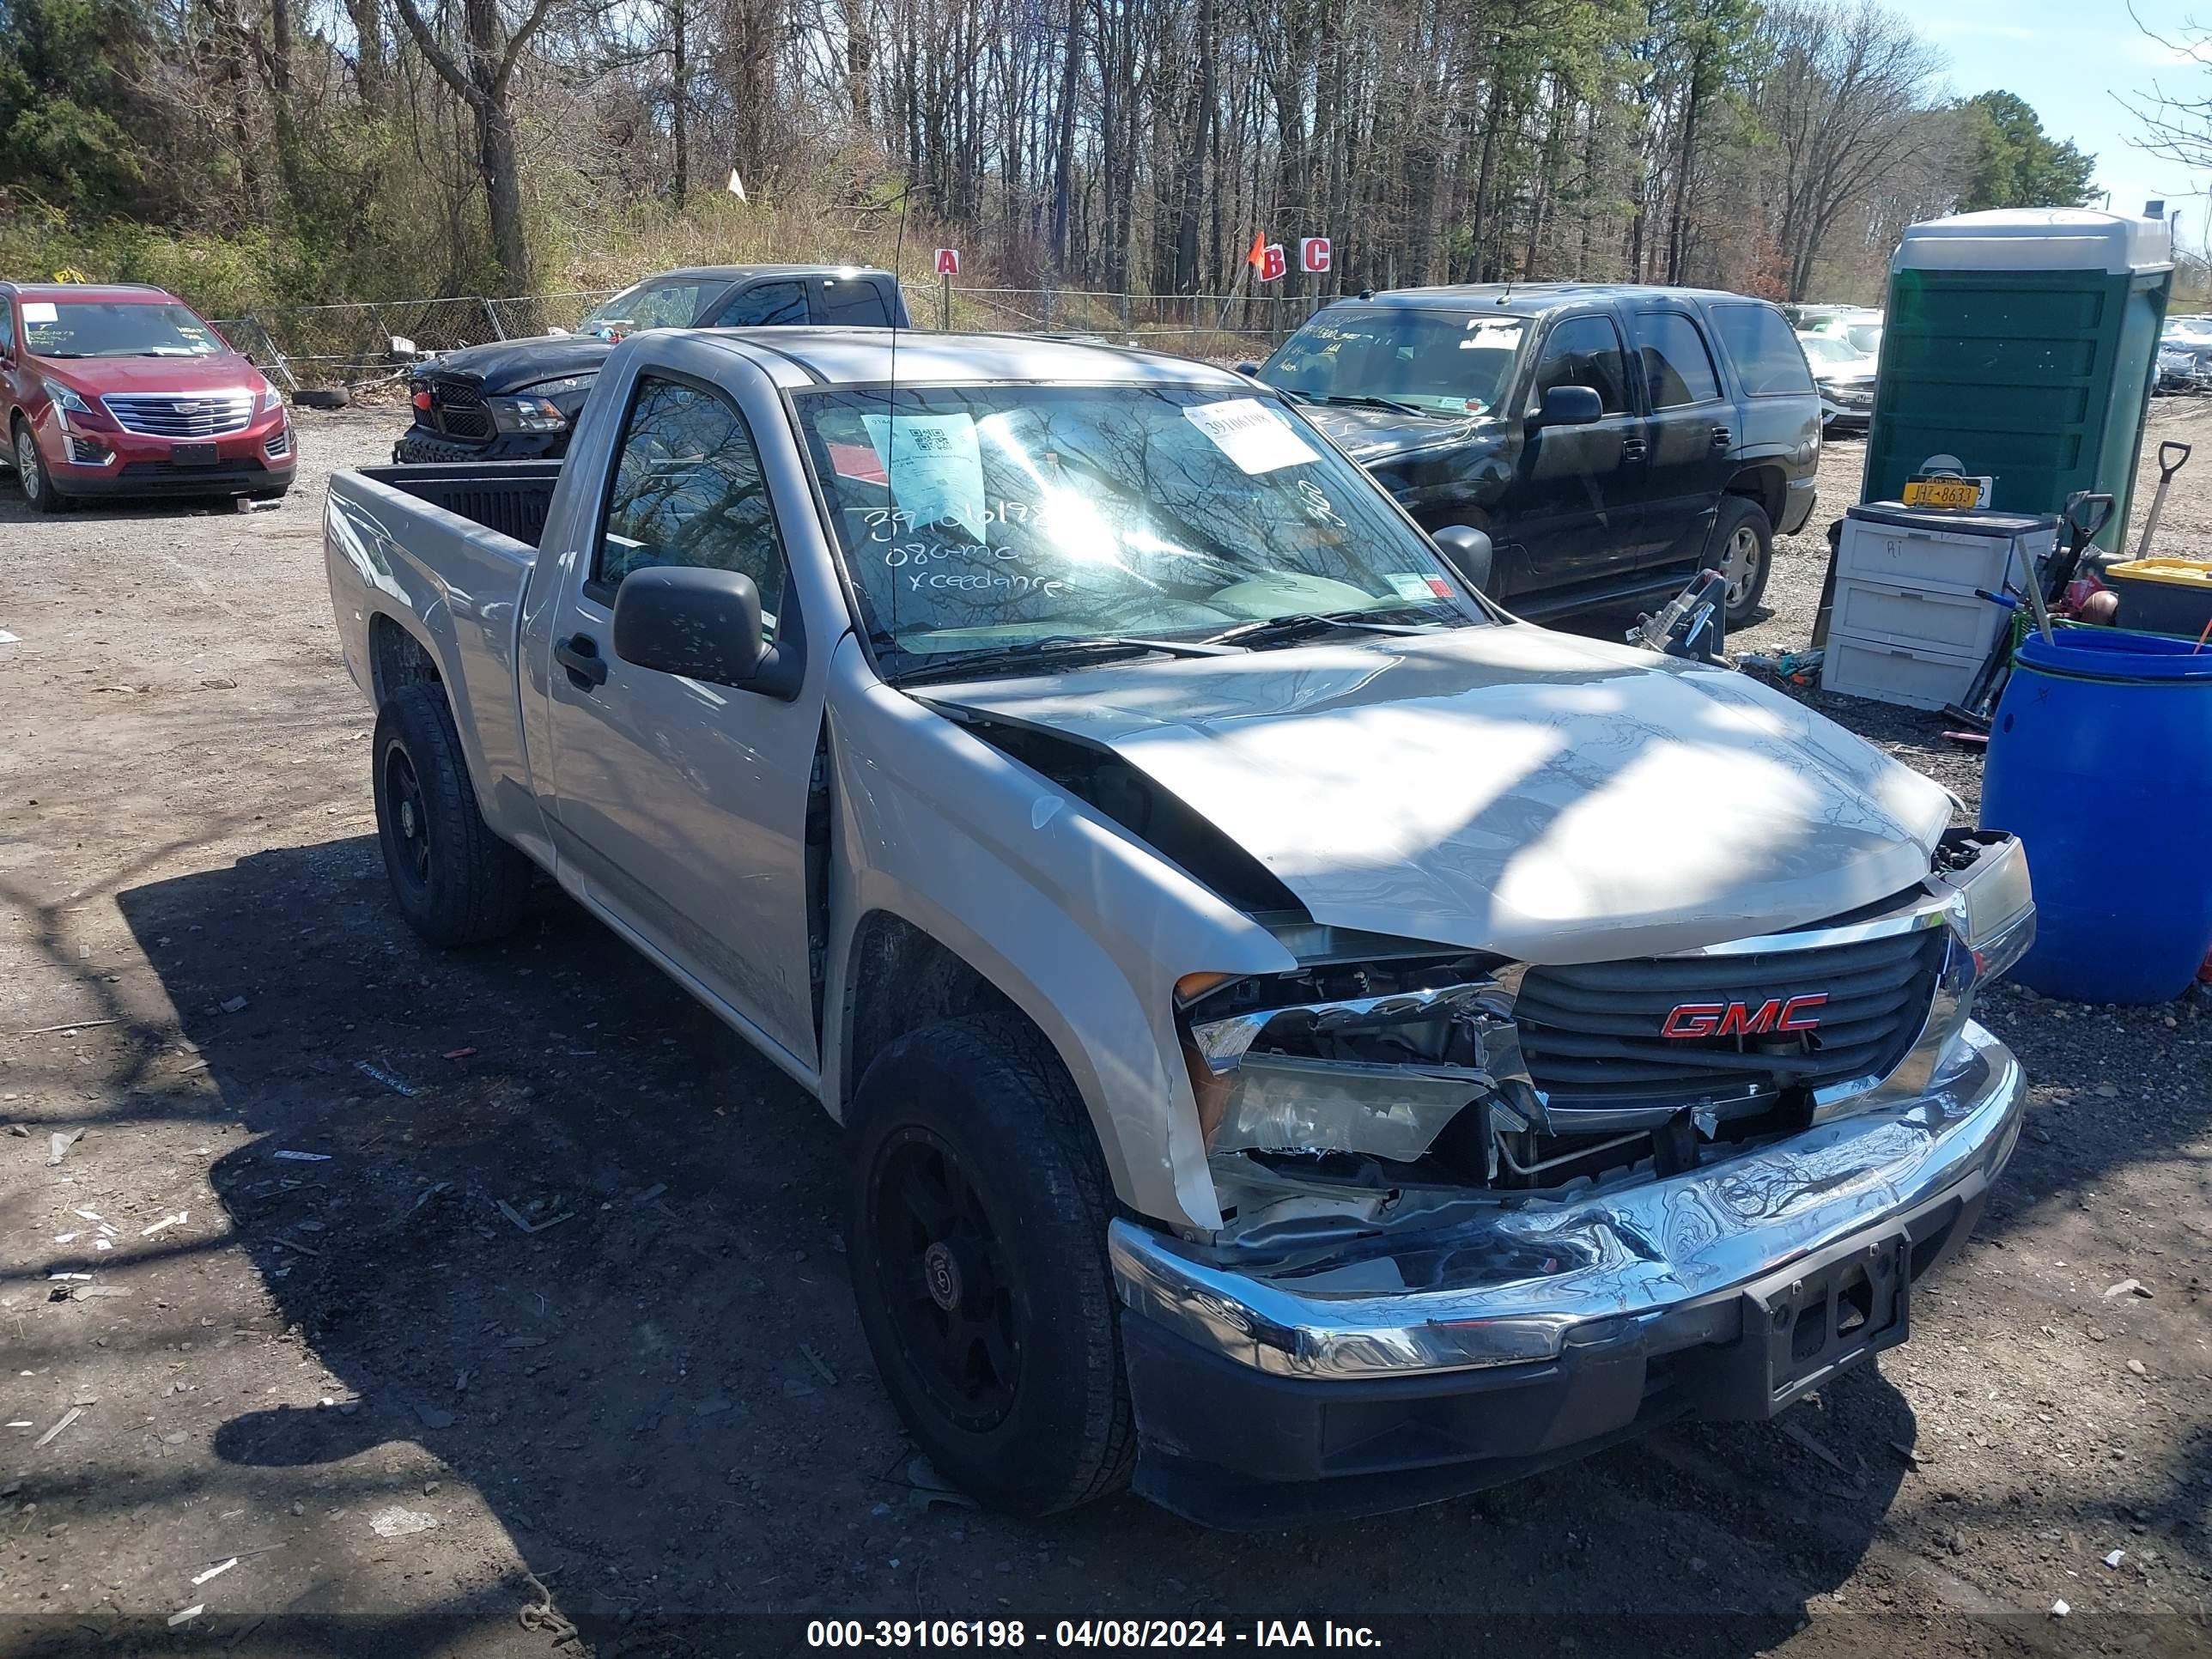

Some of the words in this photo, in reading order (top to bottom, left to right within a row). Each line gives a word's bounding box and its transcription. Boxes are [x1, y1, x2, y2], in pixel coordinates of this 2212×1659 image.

[938, 251, 958, 273] A
[1262, 249, 1284, 279] B
[1306, 240, 1329, 270] C
[1660, 992, 1830, 1039] GMC
